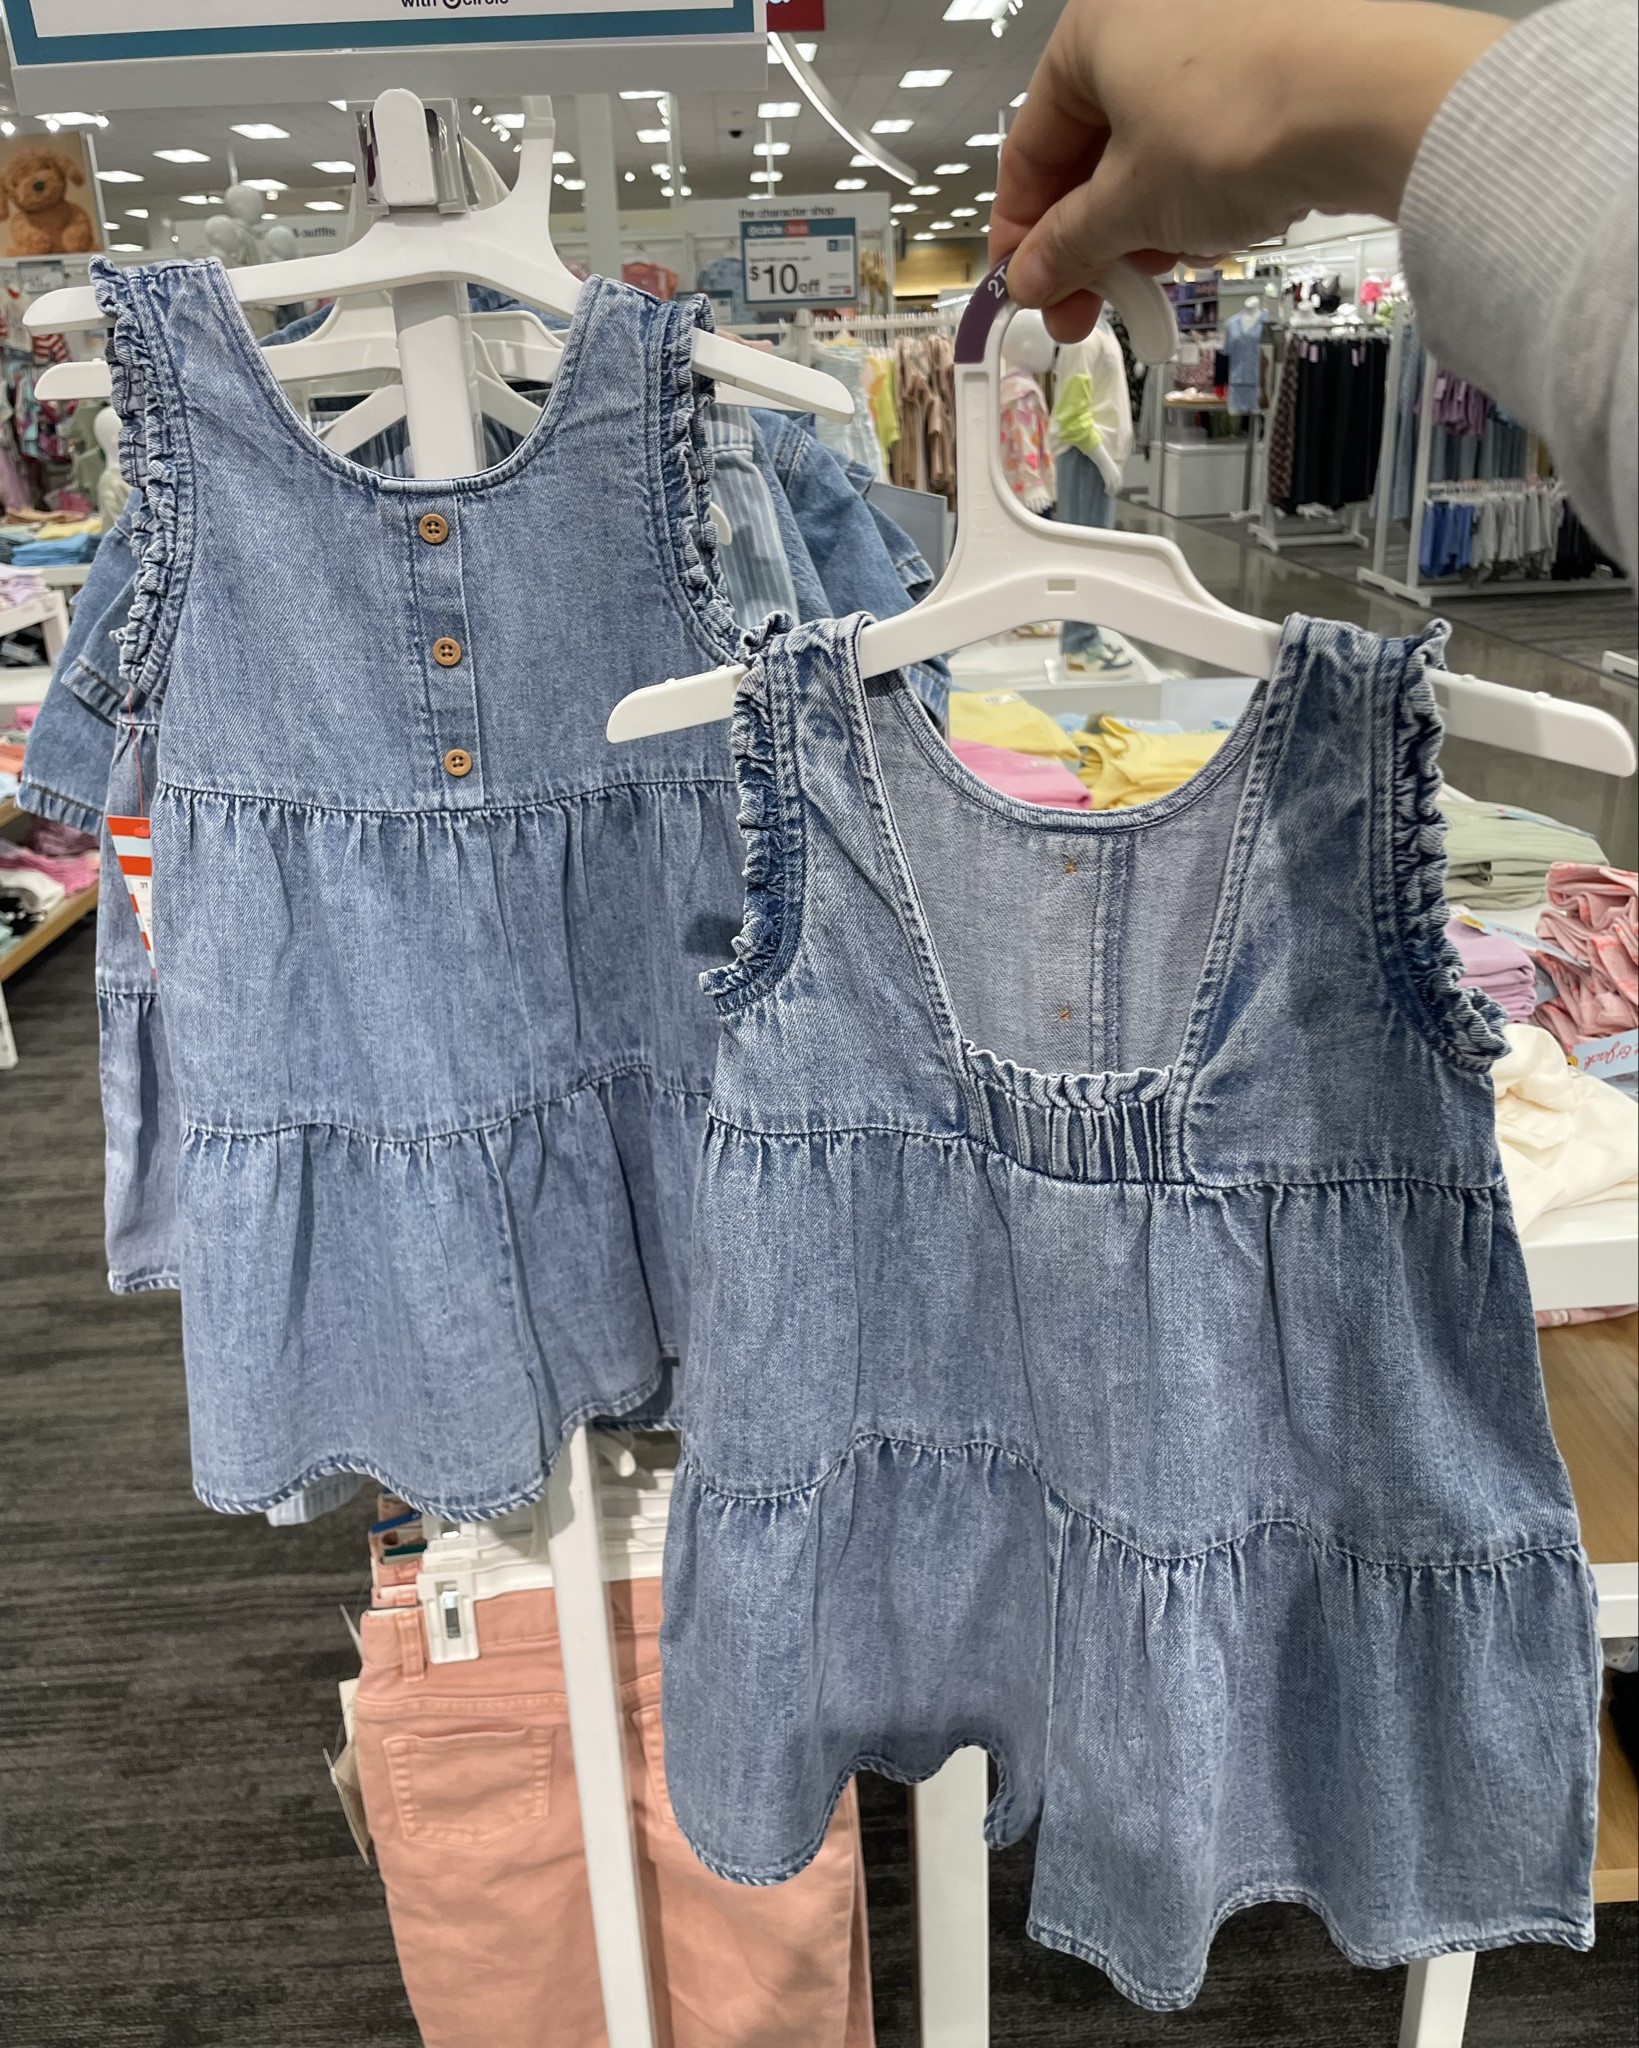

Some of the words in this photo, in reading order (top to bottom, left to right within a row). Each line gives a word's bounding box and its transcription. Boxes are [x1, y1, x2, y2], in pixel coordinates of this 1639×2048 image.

[739, 208, 755, 218] the
[757, 206, 807, 217] character
[811, 205, 834, 216] shop
[749, 263, 798, 294] $10
[799, 279, 820, 293] off
[987, 265, 1007, 299] 2T
